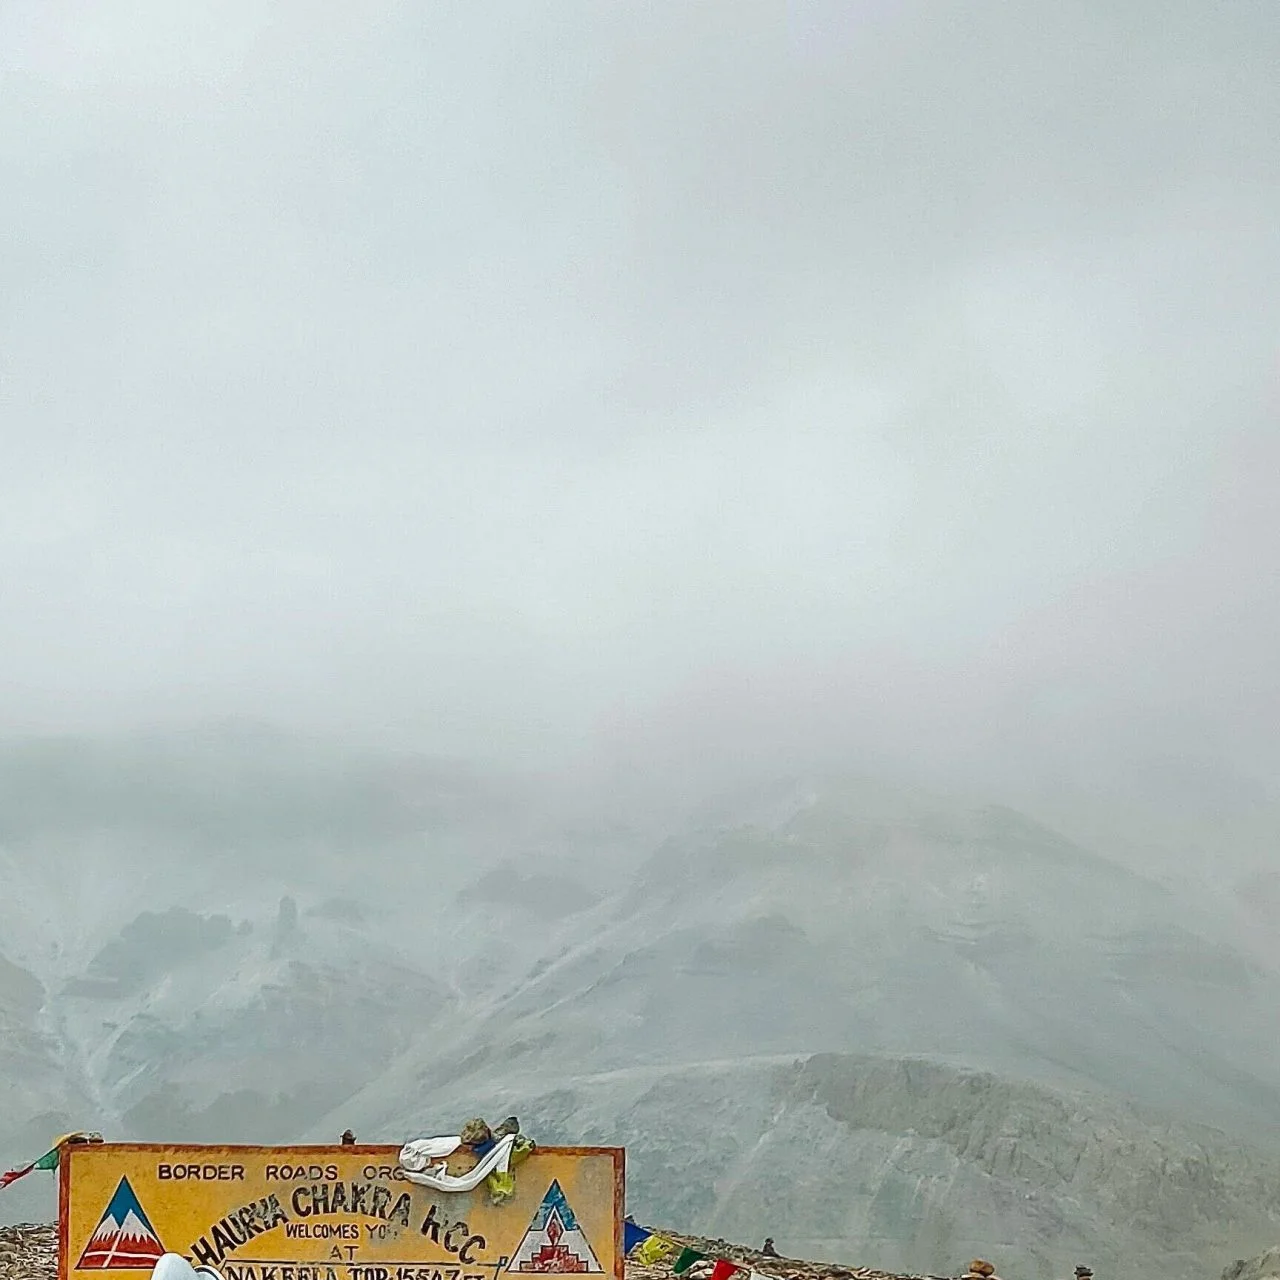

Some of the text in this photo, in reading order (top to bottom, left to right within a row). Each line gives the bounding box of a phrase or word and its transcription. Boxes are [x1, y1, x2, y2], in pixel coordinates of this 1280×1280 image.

[158, 1164, 244, 1180] BORDER
[266, 1165, 338, 1181] ROADS
[183, 1193, 290, 1266] HAURYA
[291, 1181, 412, 1228] CHAKRA
[285, 1223, 360, 1239] WELCOMES
[329, 1245, 359, 1260] AT
